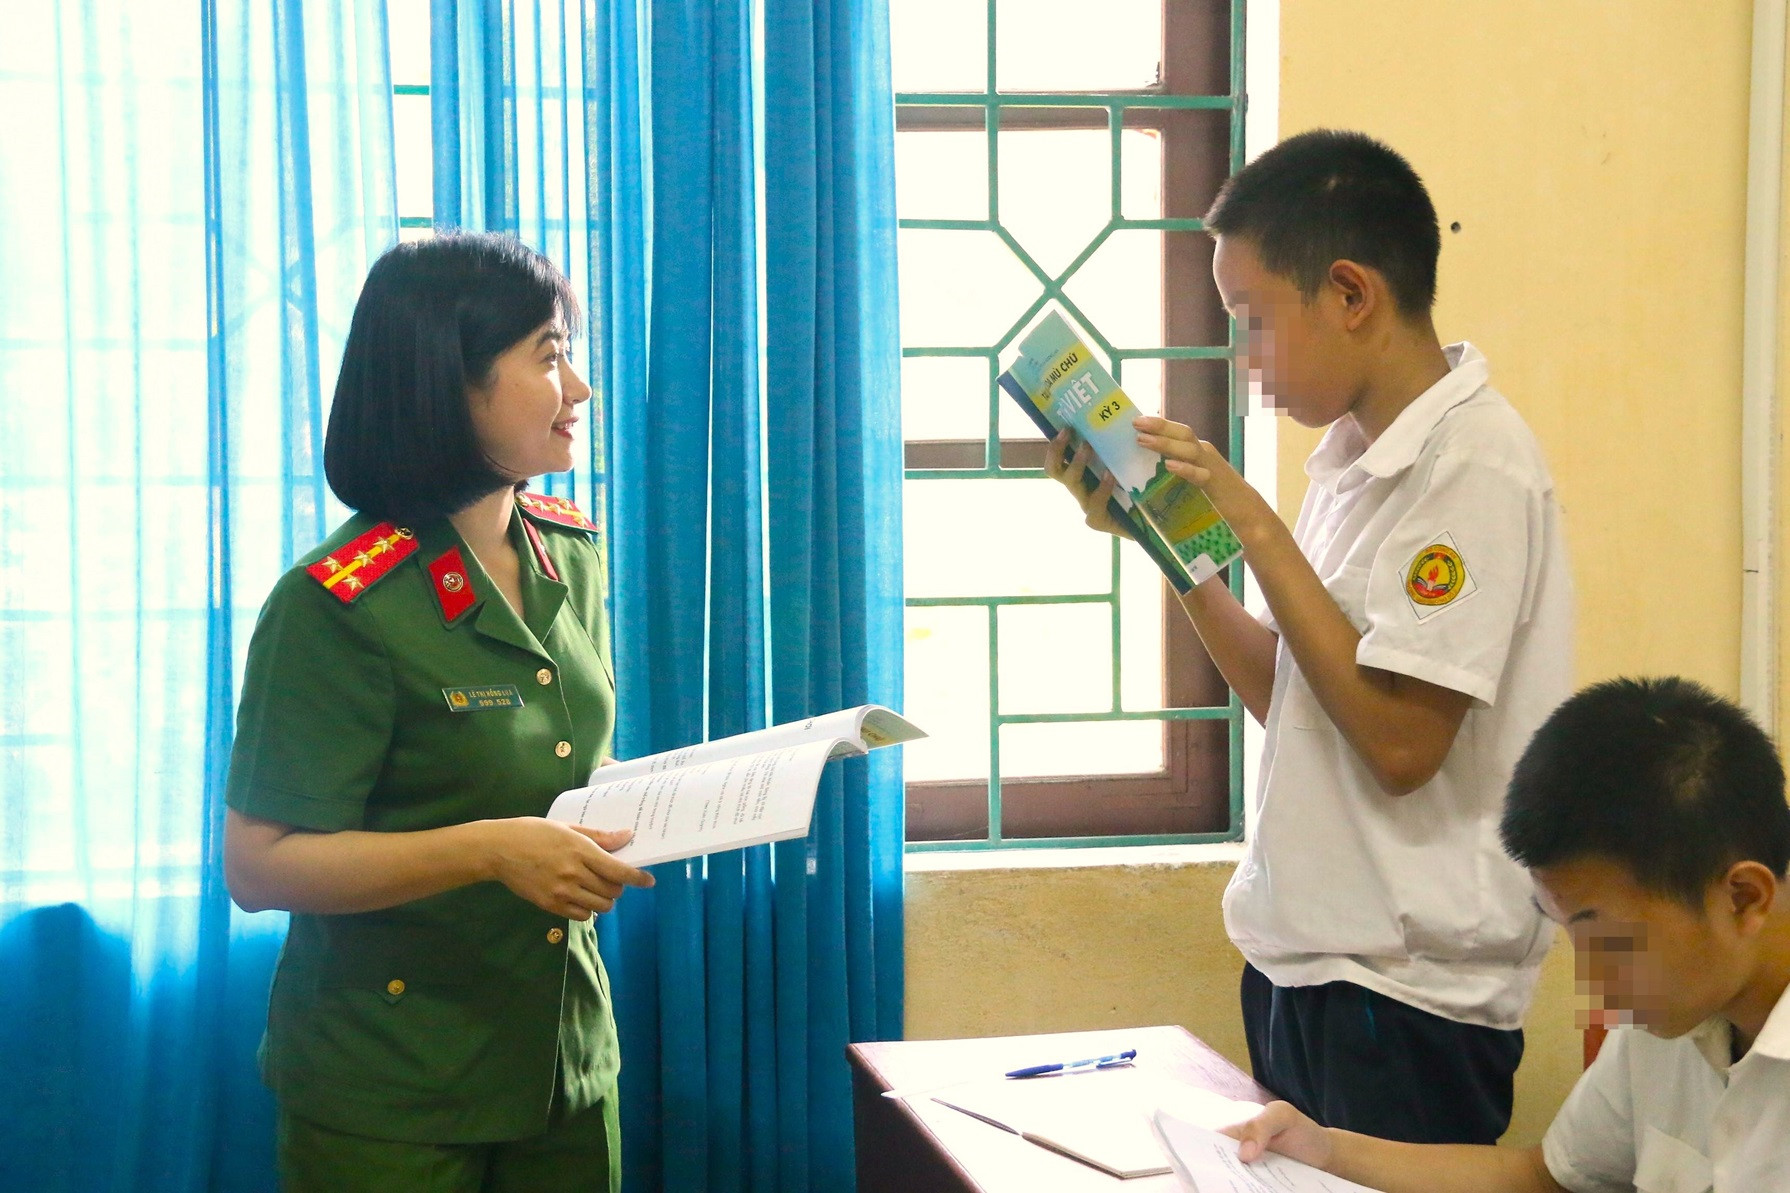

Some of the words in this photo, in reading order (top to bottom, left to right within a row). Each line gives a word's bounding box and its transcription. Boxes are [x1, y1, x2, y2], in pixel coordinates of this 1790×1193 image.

[1049, 366, 1062, 384] MÙ
[1059, 371, 1100, 414] VIỆT
[1099, 404, 1113, 422] KỲ
[1111, 400, 1121, 411] 3
